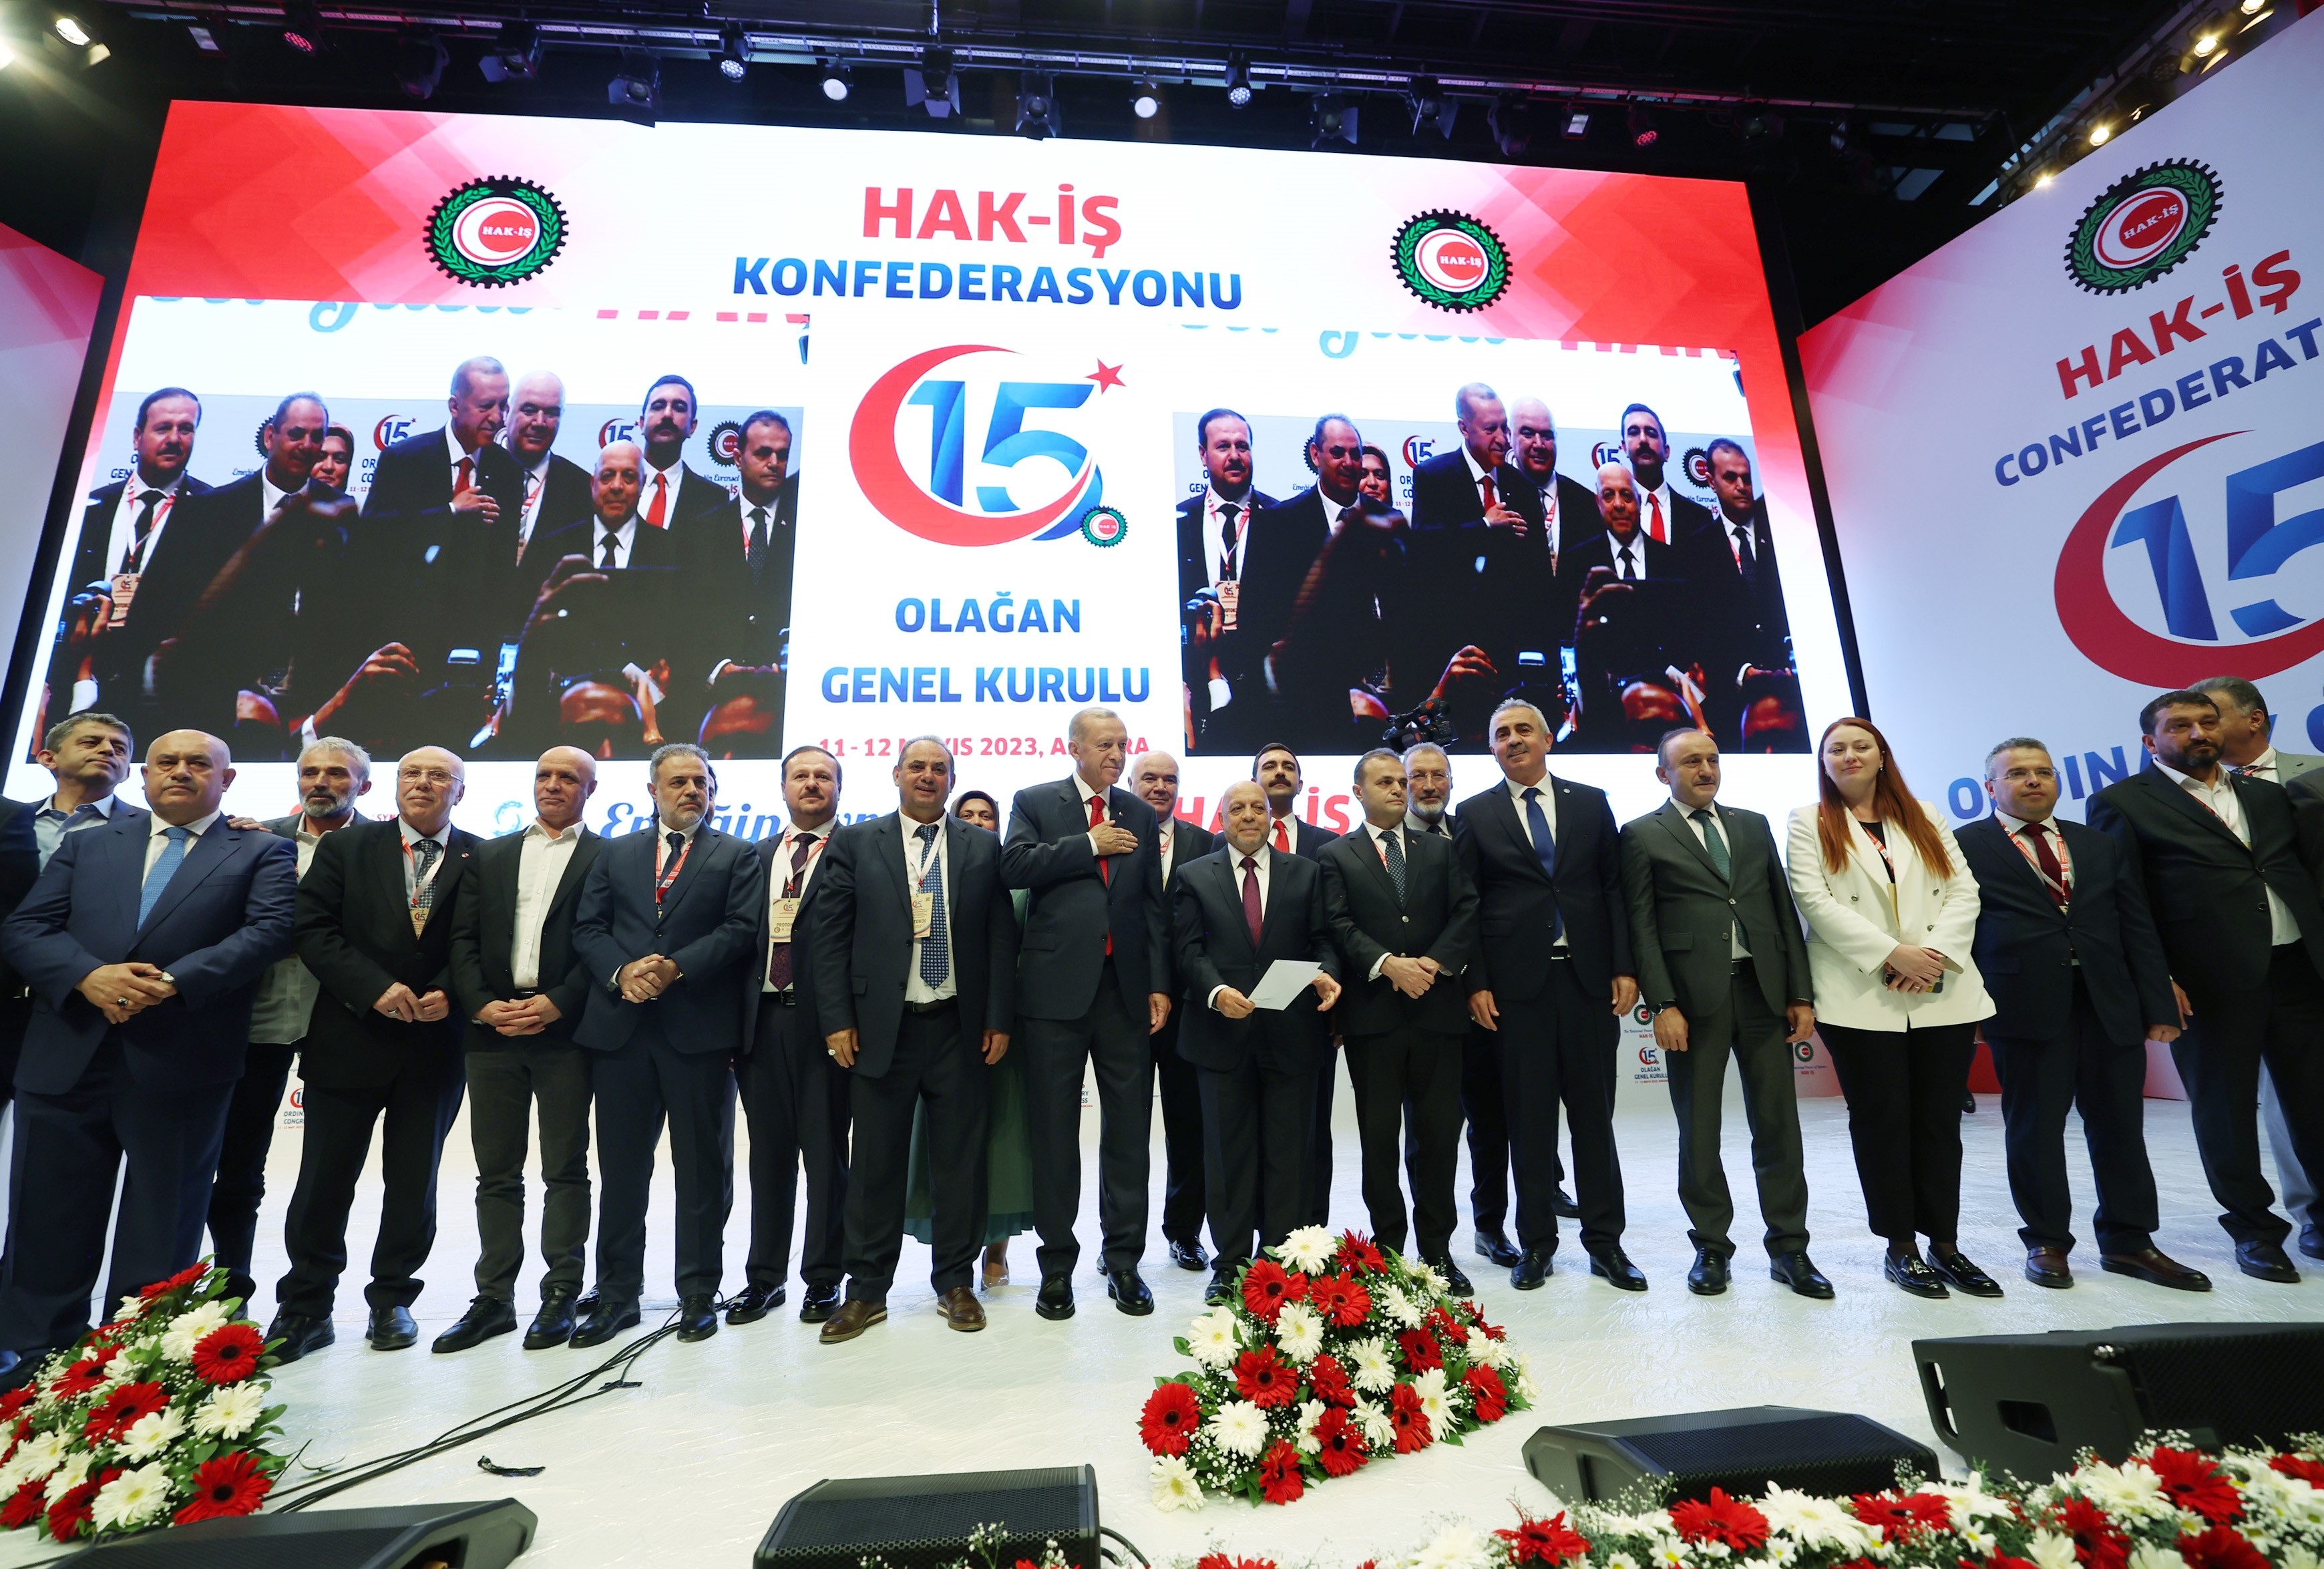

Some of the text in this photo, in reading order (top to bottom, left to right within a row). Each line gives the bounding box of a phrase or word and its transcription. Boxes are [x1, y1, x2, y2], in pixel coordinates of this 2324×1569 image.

[482, 226, 532, 238] HAK-İŞ
[862, 184, 1121, 258] HAK-İŞ
[2124, 203, 2178, 240] HAK-İŞ
[1440, 255, 1482, 268] HAK-İŞ
[733, 256, 1242, 310] KONFEDERASYONU
[2056, 249, 2301, 400] HAK-İŞ
[1994, 317, 2323, 486] CONFEDERAT
[111, 468, 134, 478] GEN
[907, 379, 1103, 541] 15
[1189, 483, 1209, 492] GEN
[895, 591, 1080, 633] OLAĞAN
[821, 667, 1150, 703] GENEL KURULU
[865, 738, 891, 756] 12
[980, 737, 1043, 759] 2023,
